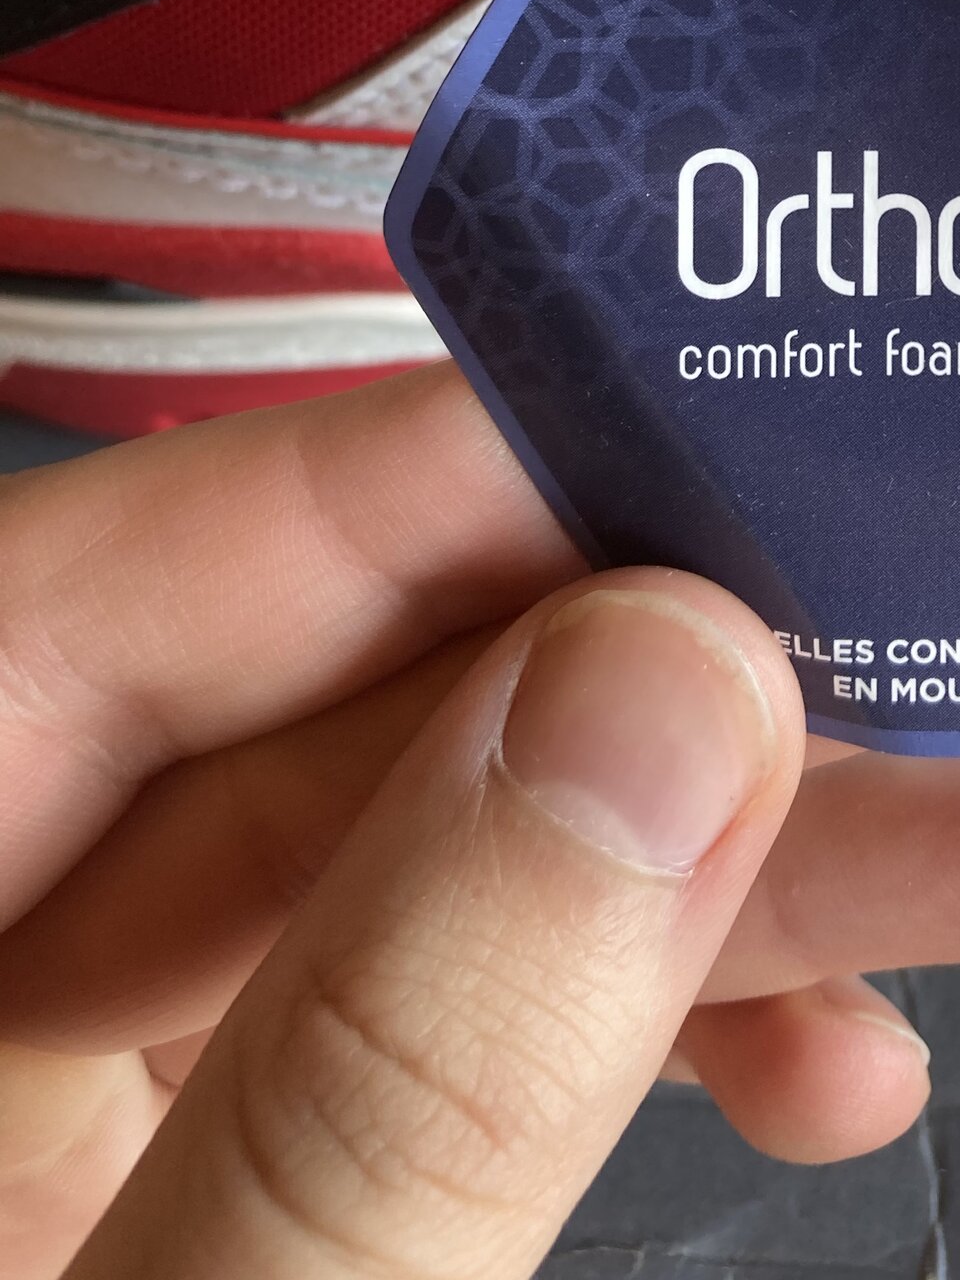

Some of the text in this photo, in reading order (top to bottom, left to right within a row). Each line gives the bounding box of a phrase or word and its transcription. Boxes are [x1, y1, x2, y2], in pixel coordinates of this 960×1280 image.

[679, 328, 863, 380] comfort
[773, 630, 875, 664] ELLES
[833, 674, 878, 702] EN
